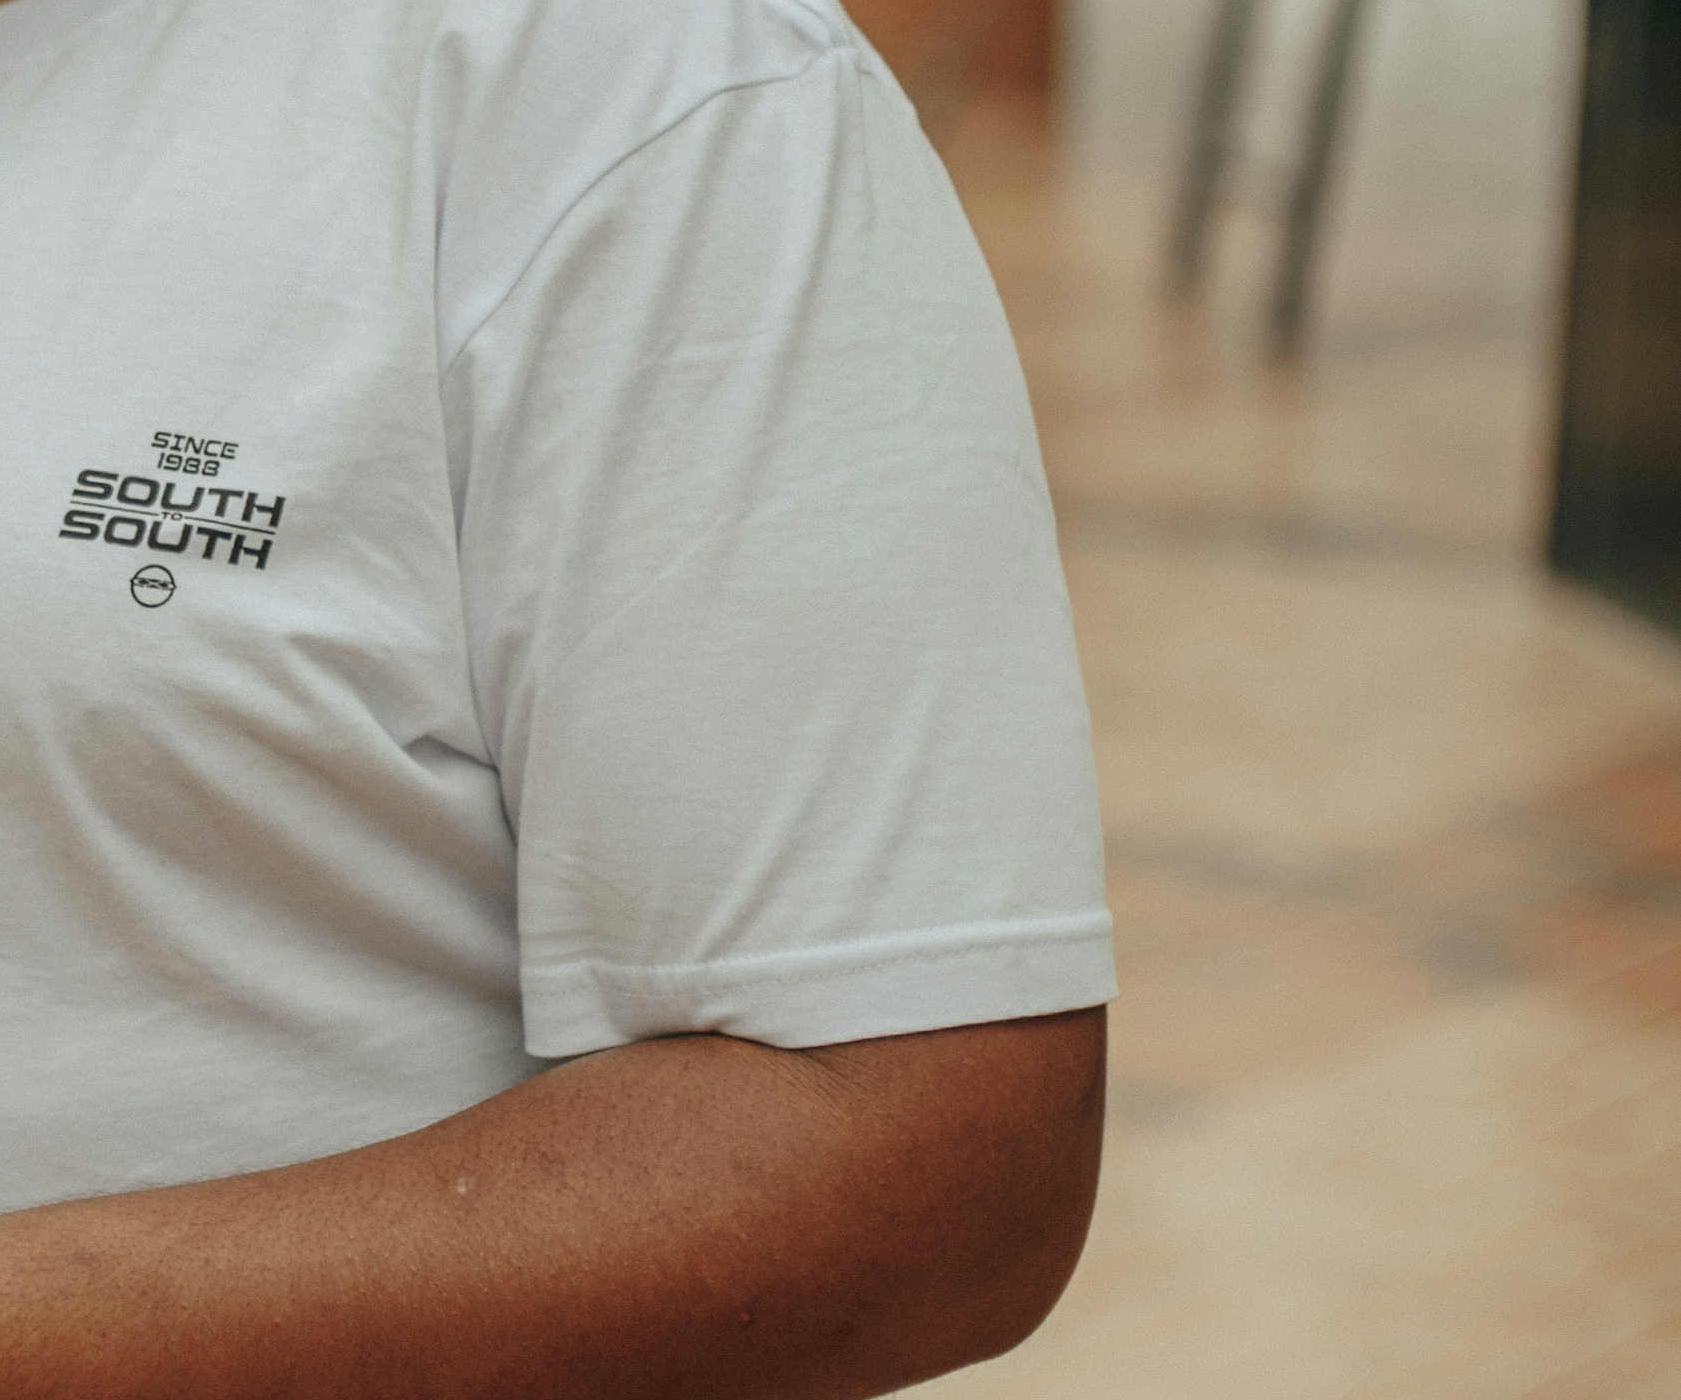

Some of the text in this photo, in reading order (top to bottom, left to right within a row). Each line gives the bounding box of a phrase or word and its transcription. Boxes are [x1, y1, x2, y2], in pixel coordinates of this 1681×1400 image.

[151, 431, 240, 460] SINCE
[157, 452, 221, 477] 1988
[72, 469, 287, 529] SOUTH
[160, 511, 184, 522] TO
[58, 509, 273, 571] SOUTH
